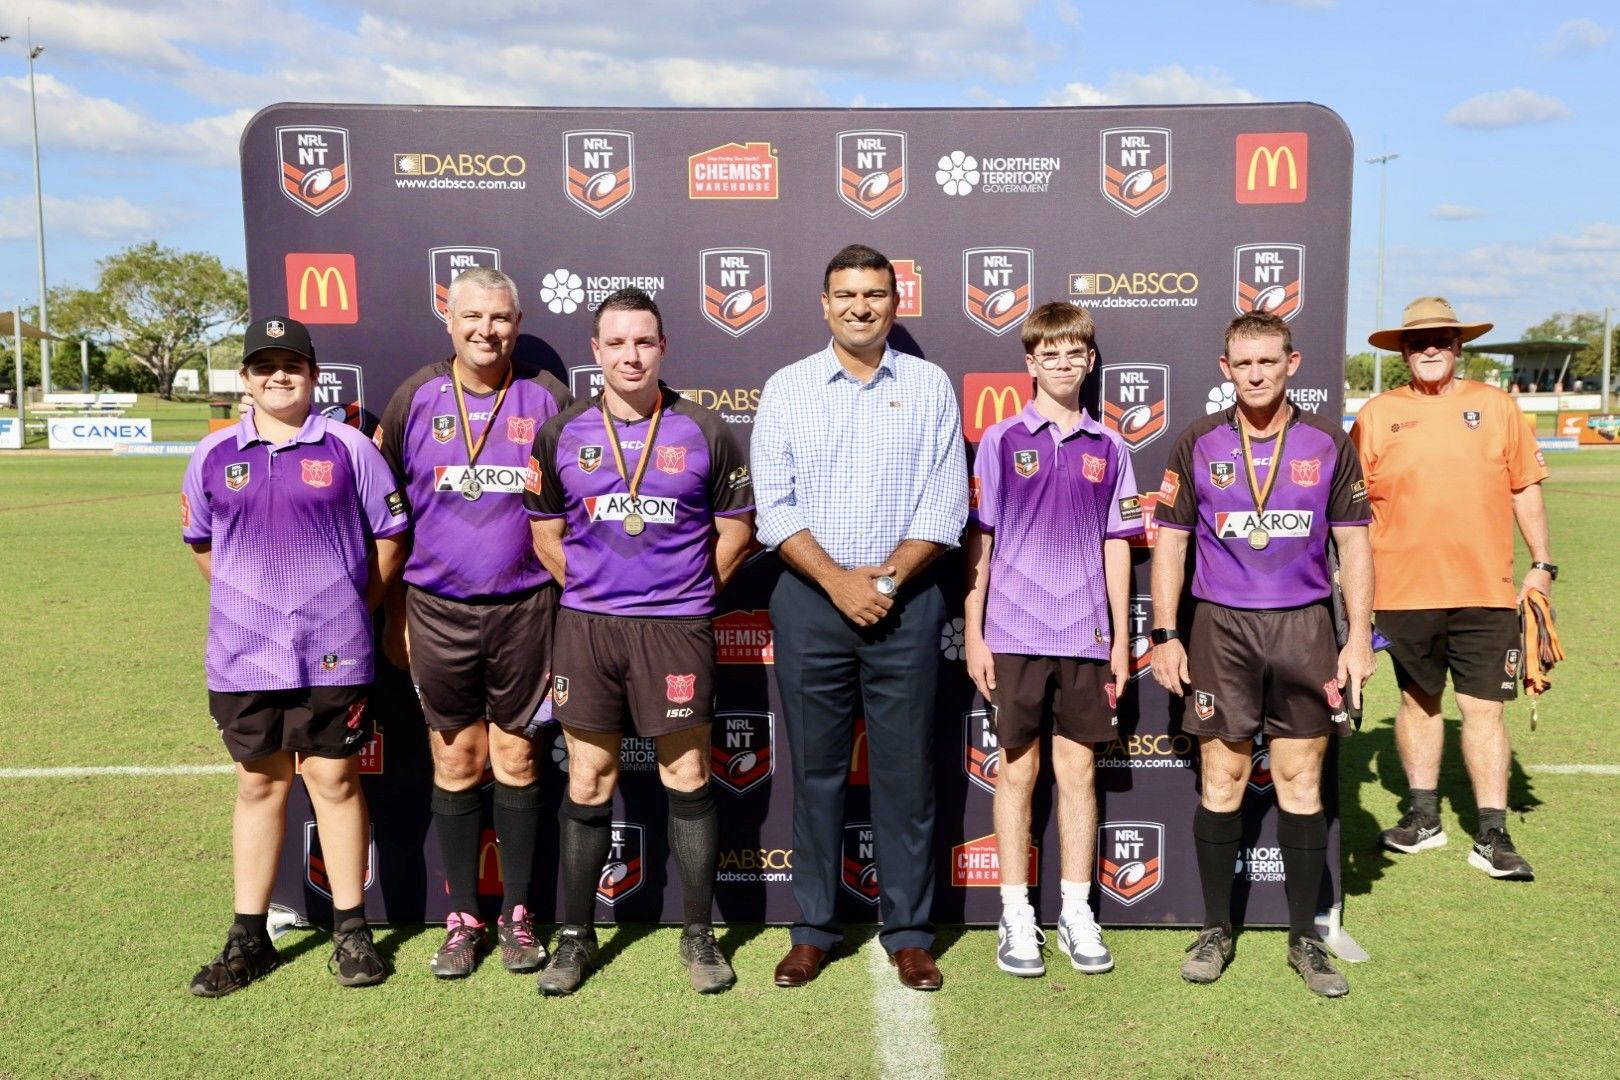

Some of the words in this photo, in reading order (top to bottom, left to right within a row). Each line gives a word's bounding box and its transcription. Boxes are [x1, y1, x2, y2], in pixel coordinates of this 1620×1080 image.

[298, 134, 327, 147] NRL
[584, 138, 613, 150] NRL
[857, 138, 886, 150] NRL
[1121, 136, 1150, 148] NRL
[298, 148, 328, 165] NT
[584, 151, 613, 168] NT
[857, 152, 887, 169] NT
[1121, 150, 1150, 167] NT
[421, 154, 526, 176] DABSCO
[982, 158, 1060, 171] NORTHERN
[695, 163, 772, 181] CHEMIST
[982, 171, 1053, 184] TERRITORY
[395, 178, 526, 190] www.dabsco.com.au
[695, 182, 770, 192] WAREHOUSE
[983, 184, 1048, 193] GOVERNMENT
[450, 255, 479, 267] NRL
[720, 257, 749, 268] NRL
[983, 256, 1012, 268] NRL
[1255, 252, 1284, 264] NRL
[721, 270, 750, 287] NT
[984, 269, 1013, 286] NT
[1255, 266, 1284, 283] NT
[587, 276, 664, 290] NORTHERN
[1096, 272, 1198, 295] DABSCO
[1069, 296, 1198, 308] www.dabsco.com.au
[1120, 372, 1149, 384] NRL
[314, 385, 342, 403] NT
[699, 389, 761, 411] DABS
[1120, 385, 1149, 402] NT
[1286, 389, 1328, 402] THERN
[72, 425, 147, 438] CANEX
[607, 496, 675, 516] AKRON
[1243, 513, 1311, 531] AKRON
[1130, 604, 1147, 615] RL
[714, 630, 774, 646] HEMIST
[721, 648, 774, 656] REHOUSE
[727, 719, 754, 730] NRL
[727, 732, 754, 748] NT
[1095, 757, 1191, 768] .dabsco.com.au
[1115, 830, 1143, 841] NRL
[1115, 843, 1144, 859] NT
[957, 853, 1001, 869] CHEM
[958, 871, 999, 879] WAREH
[1246, 873, 1286, 881] GOVERN
